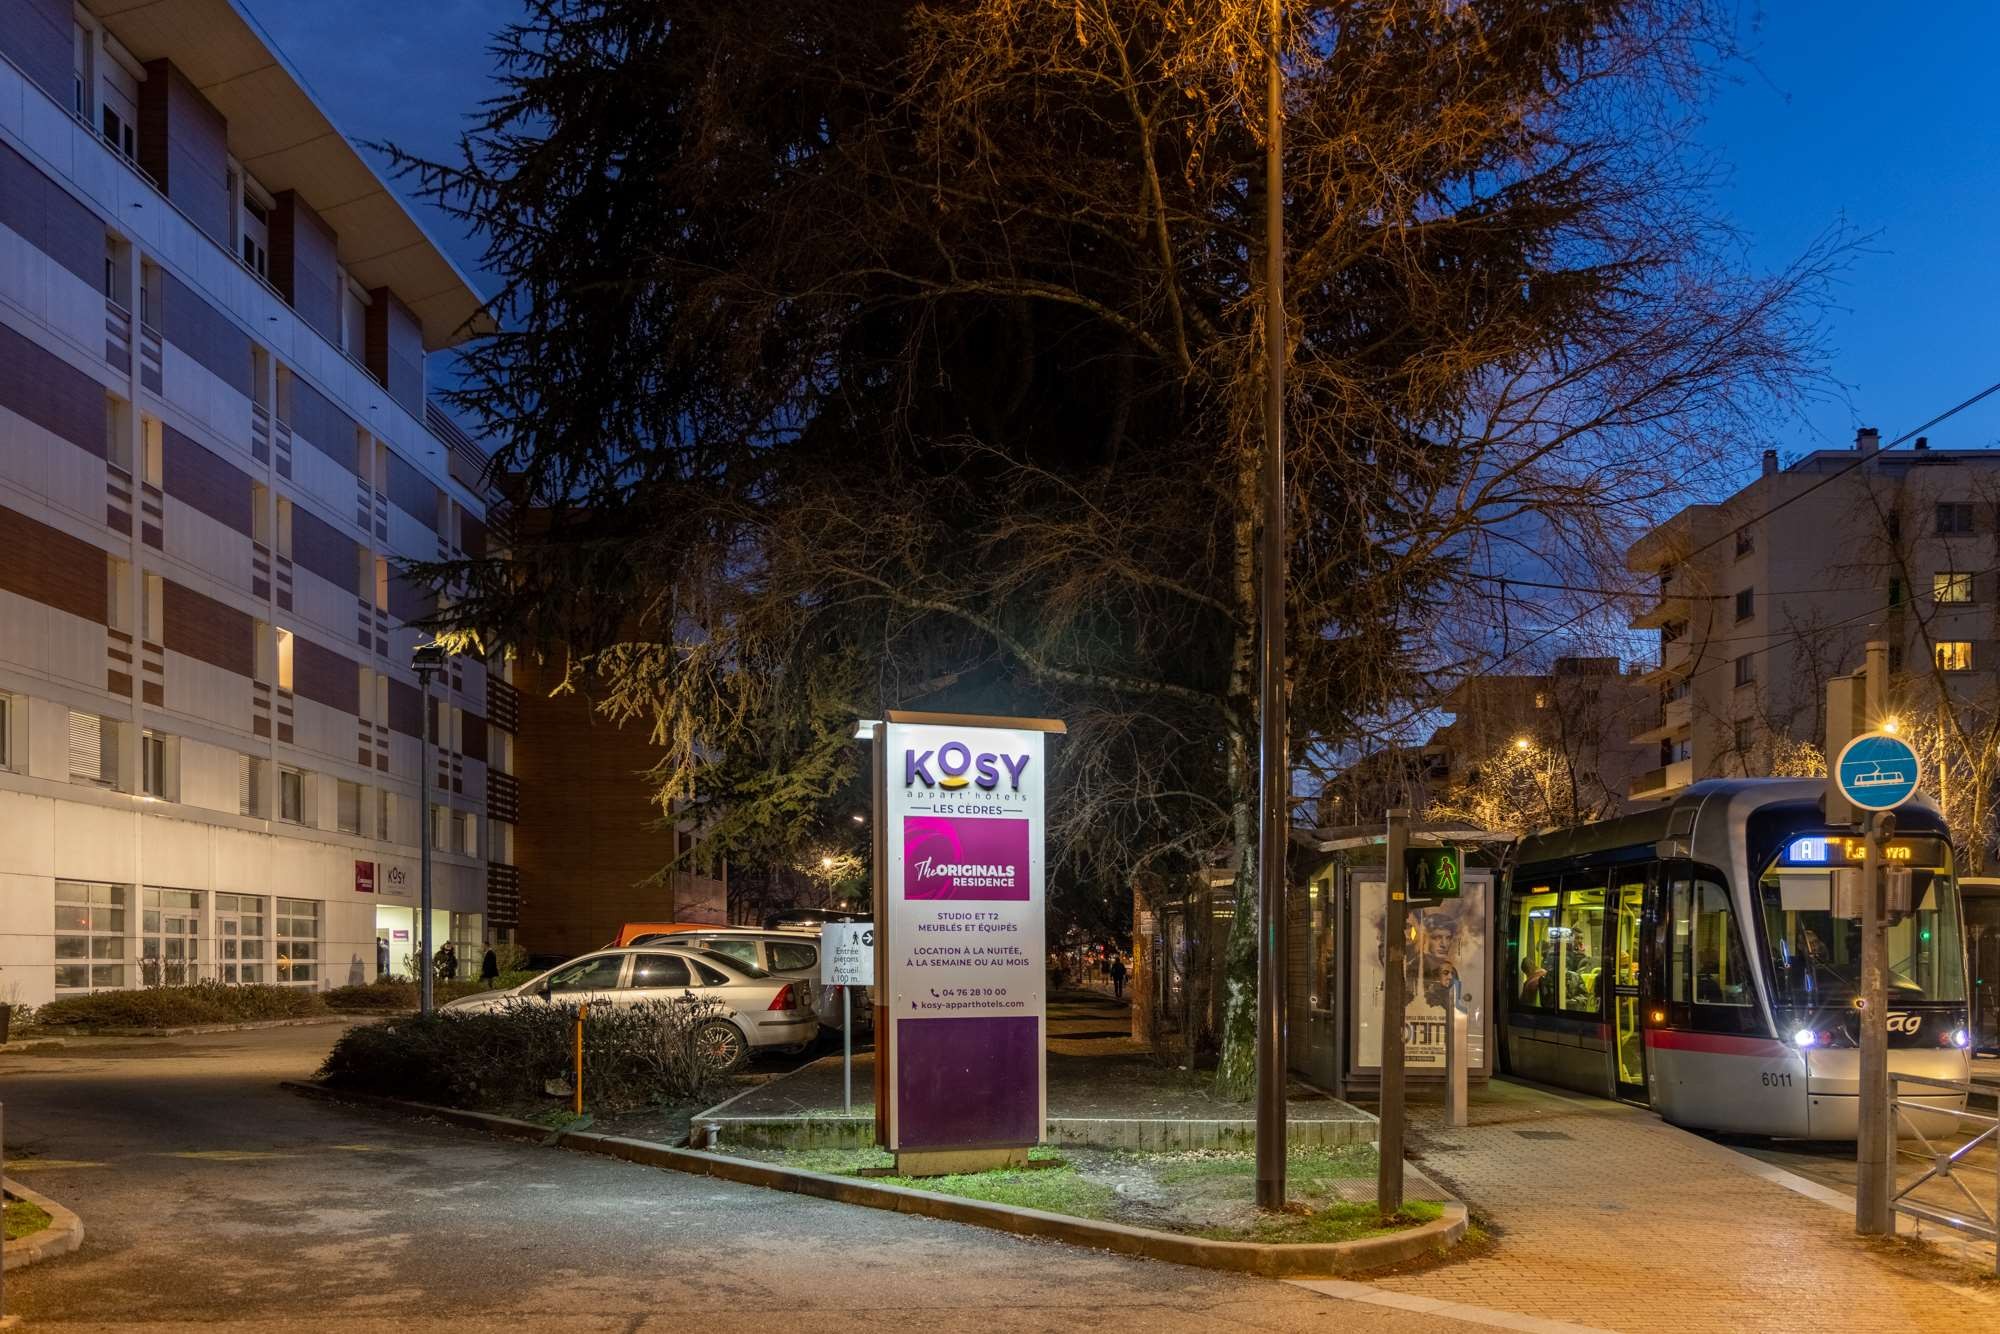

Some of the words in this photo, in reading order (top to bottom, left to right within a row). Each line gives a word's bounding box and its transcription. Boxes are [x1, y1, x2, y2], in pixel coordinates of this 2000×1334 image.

[905, 741, 1030, 790] KOSY
[933, 805, 954, 814] LES
[914, 856, 937, 881] The
[936, 864, 1015, 878] ORIGINALS
[387, 867, 407, 884] KOSY
[953, 878, 1015, 887] RESIDENCE
[937, 912, 972, 921] STUDIO
[975, 913, 986, 921] ET
[988, 912, 999, 921] T2
[918, 922, 962, 932] MEUBLÉS
[965, 924, 976, 932] ET
[978, 922, 1018, 933] ÉQUIPÉS
[836, 947, 859, 955] Entrée
[914, 947, 961, 956] LOCATION
[964, 945, 972, 955] À
[973, 947, 985, 955] LA
[987, 945, 1022, 957] NUITÉE,
[906, 957, 914, 966] À
[930, 958, 972, 967] SEMAINE
[974, 958, 988, 967] OU
[990, 958, 1004, 967] AU
[1006, 958, 1029, 967] MOIS
[837, 975, 849, 983] 100
[942, 988, 955, 997] 04
[957, 988, 968, 997] 76
[970, 988, 981, 997] 28
[983, 988, 993, 997] 10
[995, 988, 1007, 997] 00
[921, 1000, 1025, 1010] kosy-apparthotels.com
[1761, 1071, 1793, 1088] 6011
